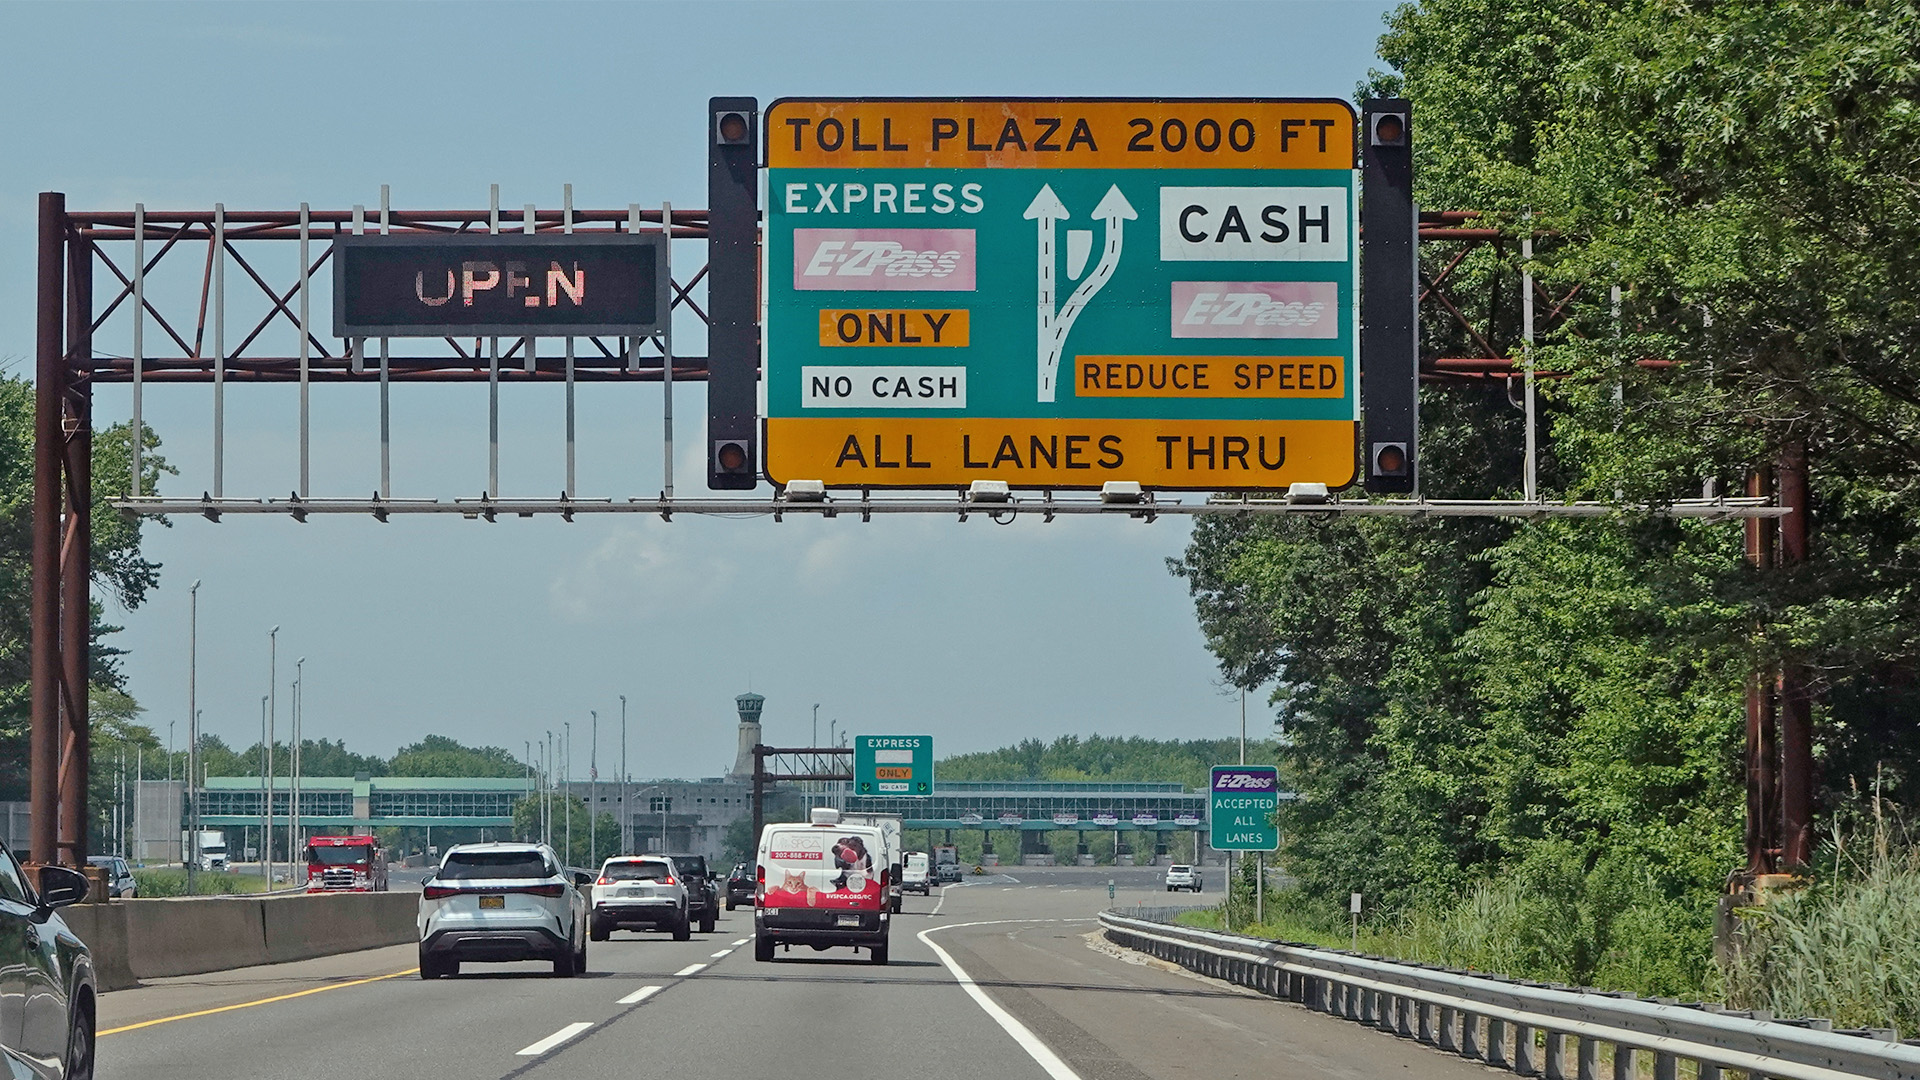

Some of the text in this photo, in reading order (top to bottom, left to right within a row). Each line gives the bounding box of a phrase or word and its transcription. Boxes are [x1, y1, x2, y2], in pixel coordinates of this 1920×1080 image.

[786, 118, 1335, 153] TOLL PLAZA 2000 FT
[785, 183, 984, 214] EXPRESS
[1178, 204, 1330, 244] CASH
[803, 240, 961, 278] E-ZPass
[1181, 293, 1325, 326] E-ZPass
[837, 313, 951, 344] ONLY
[812, 376, 957, 399] NO CASH
[1083, 363, 1337, 390] REDUCE SPEED
[835, 435, 1286, 470] ALL LANES THRU
[867, 739, 920, 748] EXPRESS
[878, 768, 909, 778] ONLY
[1215, 799, 1274, 809] ACCEPTED
[1234, 816, 1256, 826] ALL
[791, 839, 821, 849] SPCA
[1226, 833, 1263, 843] LANES
